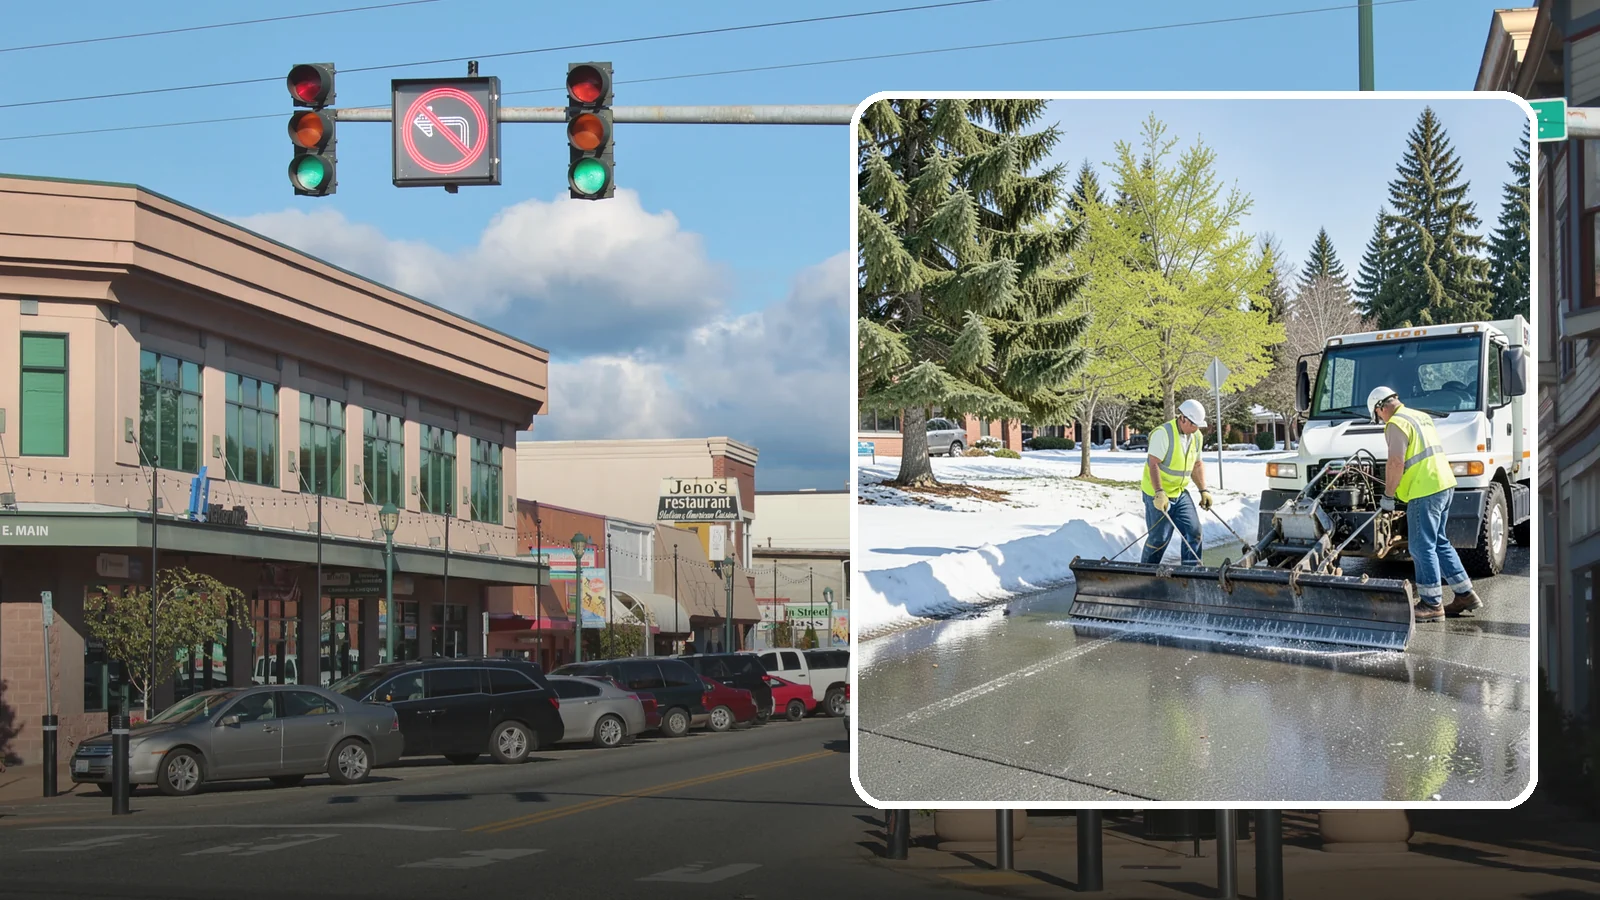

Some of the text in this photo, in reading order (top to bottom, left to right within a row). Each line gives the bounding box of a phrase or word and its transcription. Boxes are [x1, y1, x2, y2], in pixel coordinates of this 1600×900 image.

[670, 480, 728, 494] Jeno's
[665, 496, 731, 509] restaurant
[658, 509, 681, 519] Italian
[686, 509, 714, 519] American
[715, 509, 737, 519] Cuisine
[2, 525, 49, 536] E. MAIN
[797, 607, 828, 617] Street
